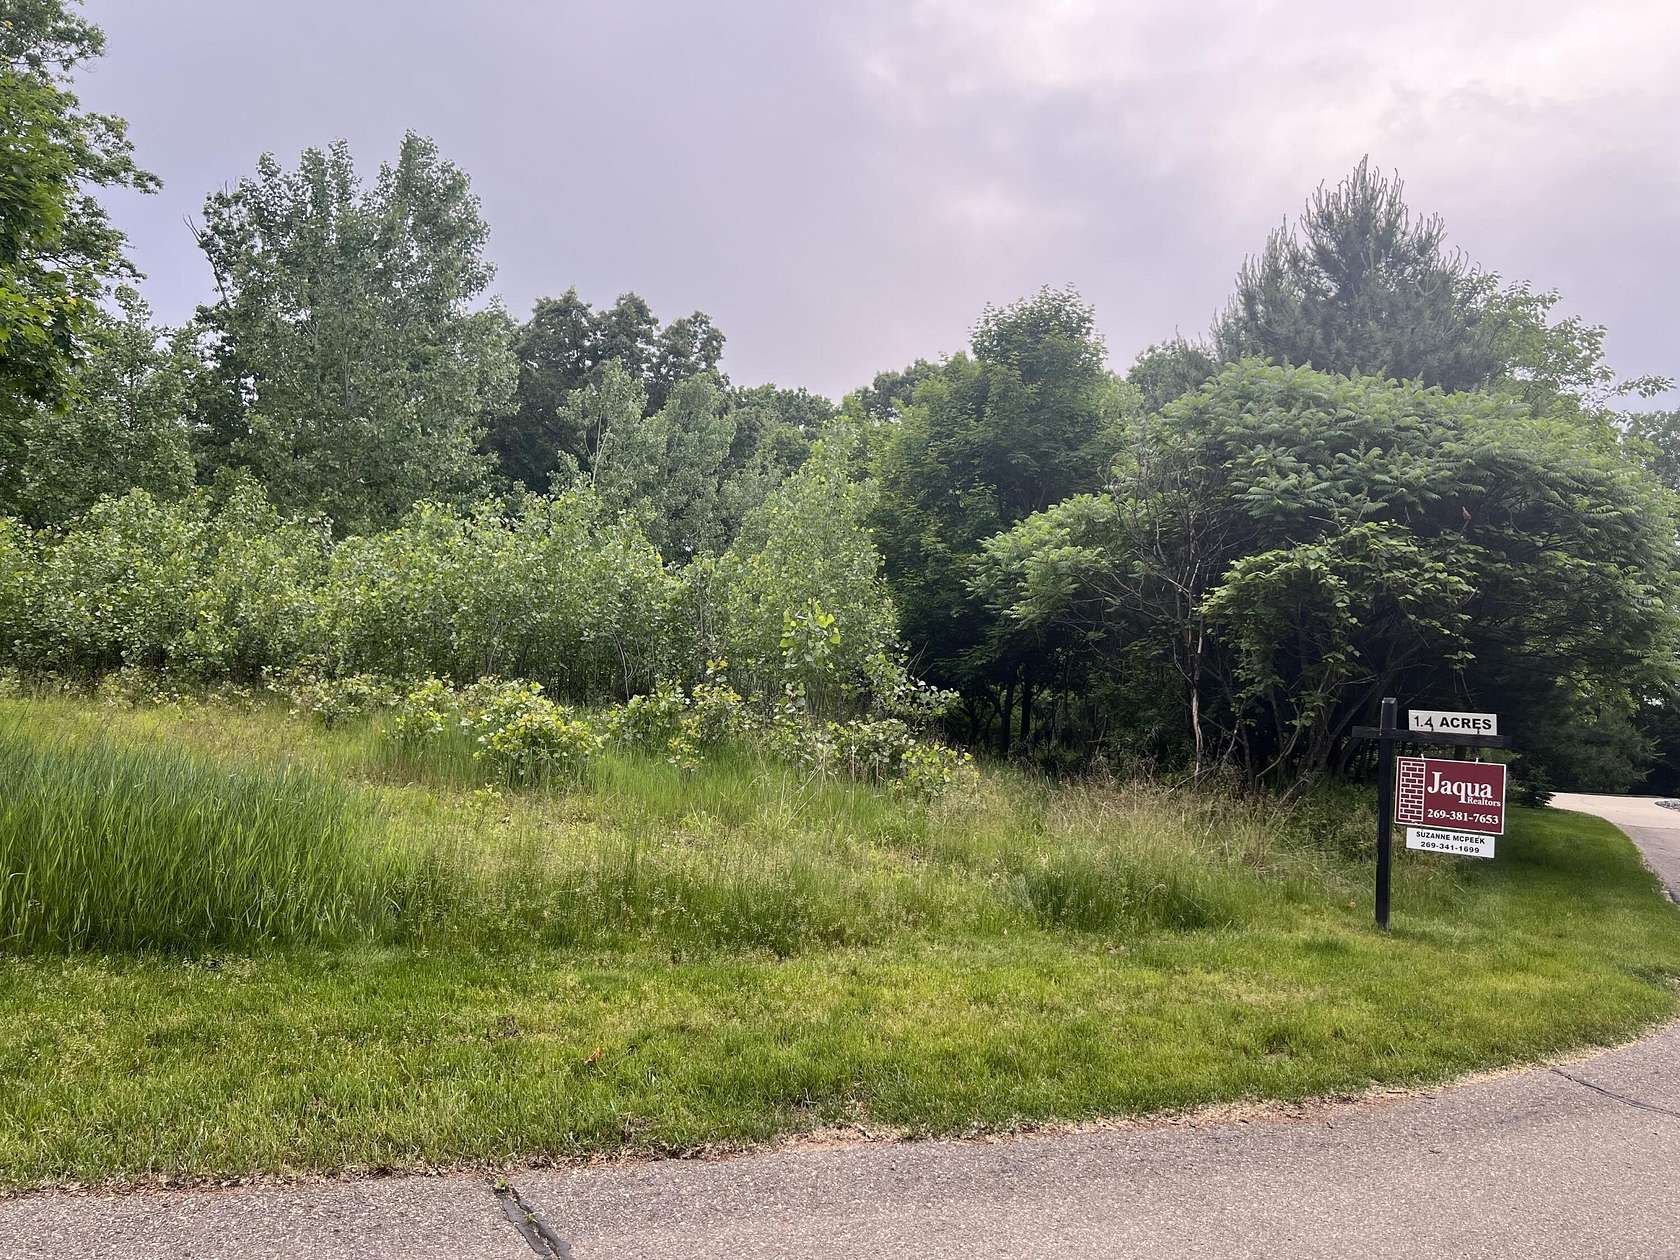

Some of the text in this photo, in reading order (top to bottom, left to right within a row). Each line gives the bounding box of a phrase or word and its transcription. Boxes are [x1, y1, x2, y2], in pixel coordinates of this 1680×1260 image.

[1414, 715, 1492, 730] 1.4 ACRES
[1427, 771, 1493, 804] Jaqua
[1467, 796, 1501, 807] Realtors
[1427, 809, 1499, 825] 269-381-7653
[1416, 831, 1485, 845] SUZANNE MCPEEK
[1420, 841, 1480, 854] 269-341-1699
